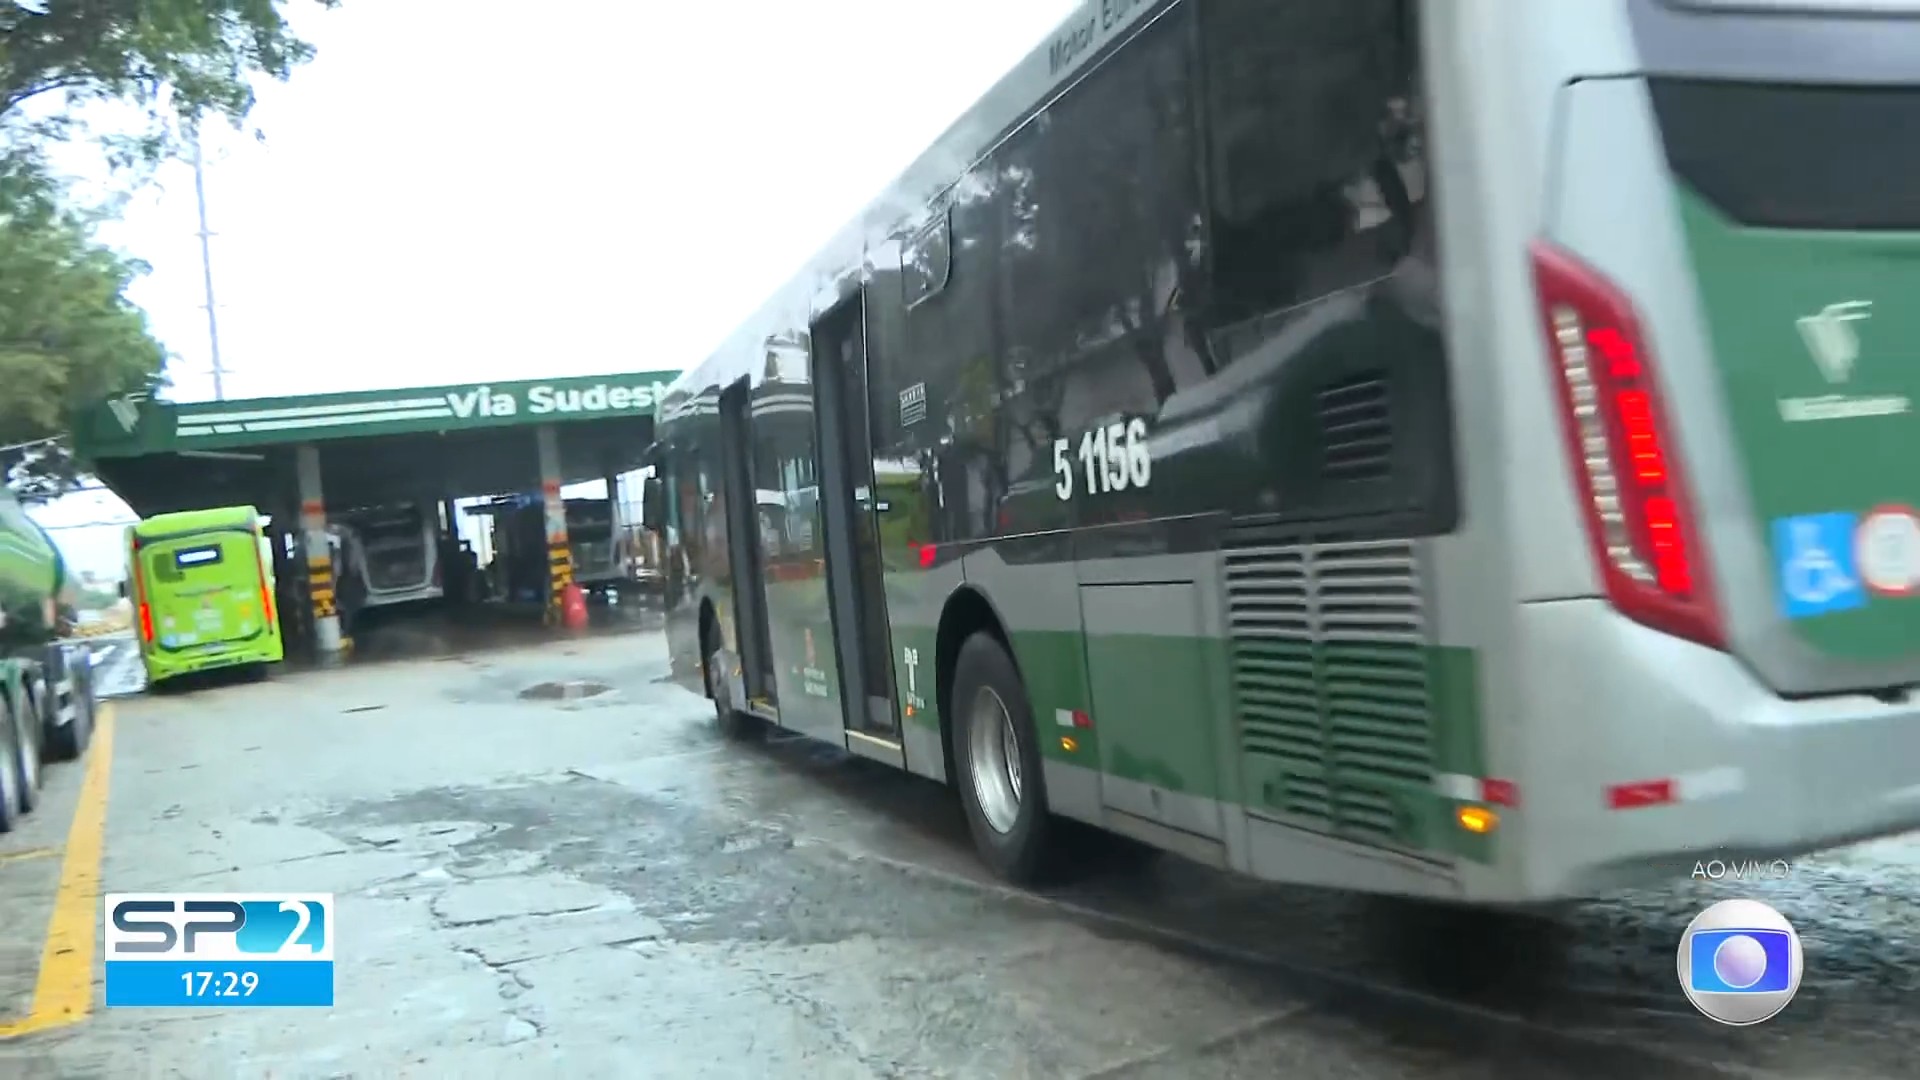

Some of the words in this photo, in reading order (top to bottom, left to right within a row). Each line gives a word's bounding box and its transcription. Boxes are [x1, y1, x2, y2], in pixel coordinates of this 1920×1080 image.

[447, 385, 517, 418] Via
[528, 381, 667, 413] Sudest
[1079, 418, 1151, 494] 1156
